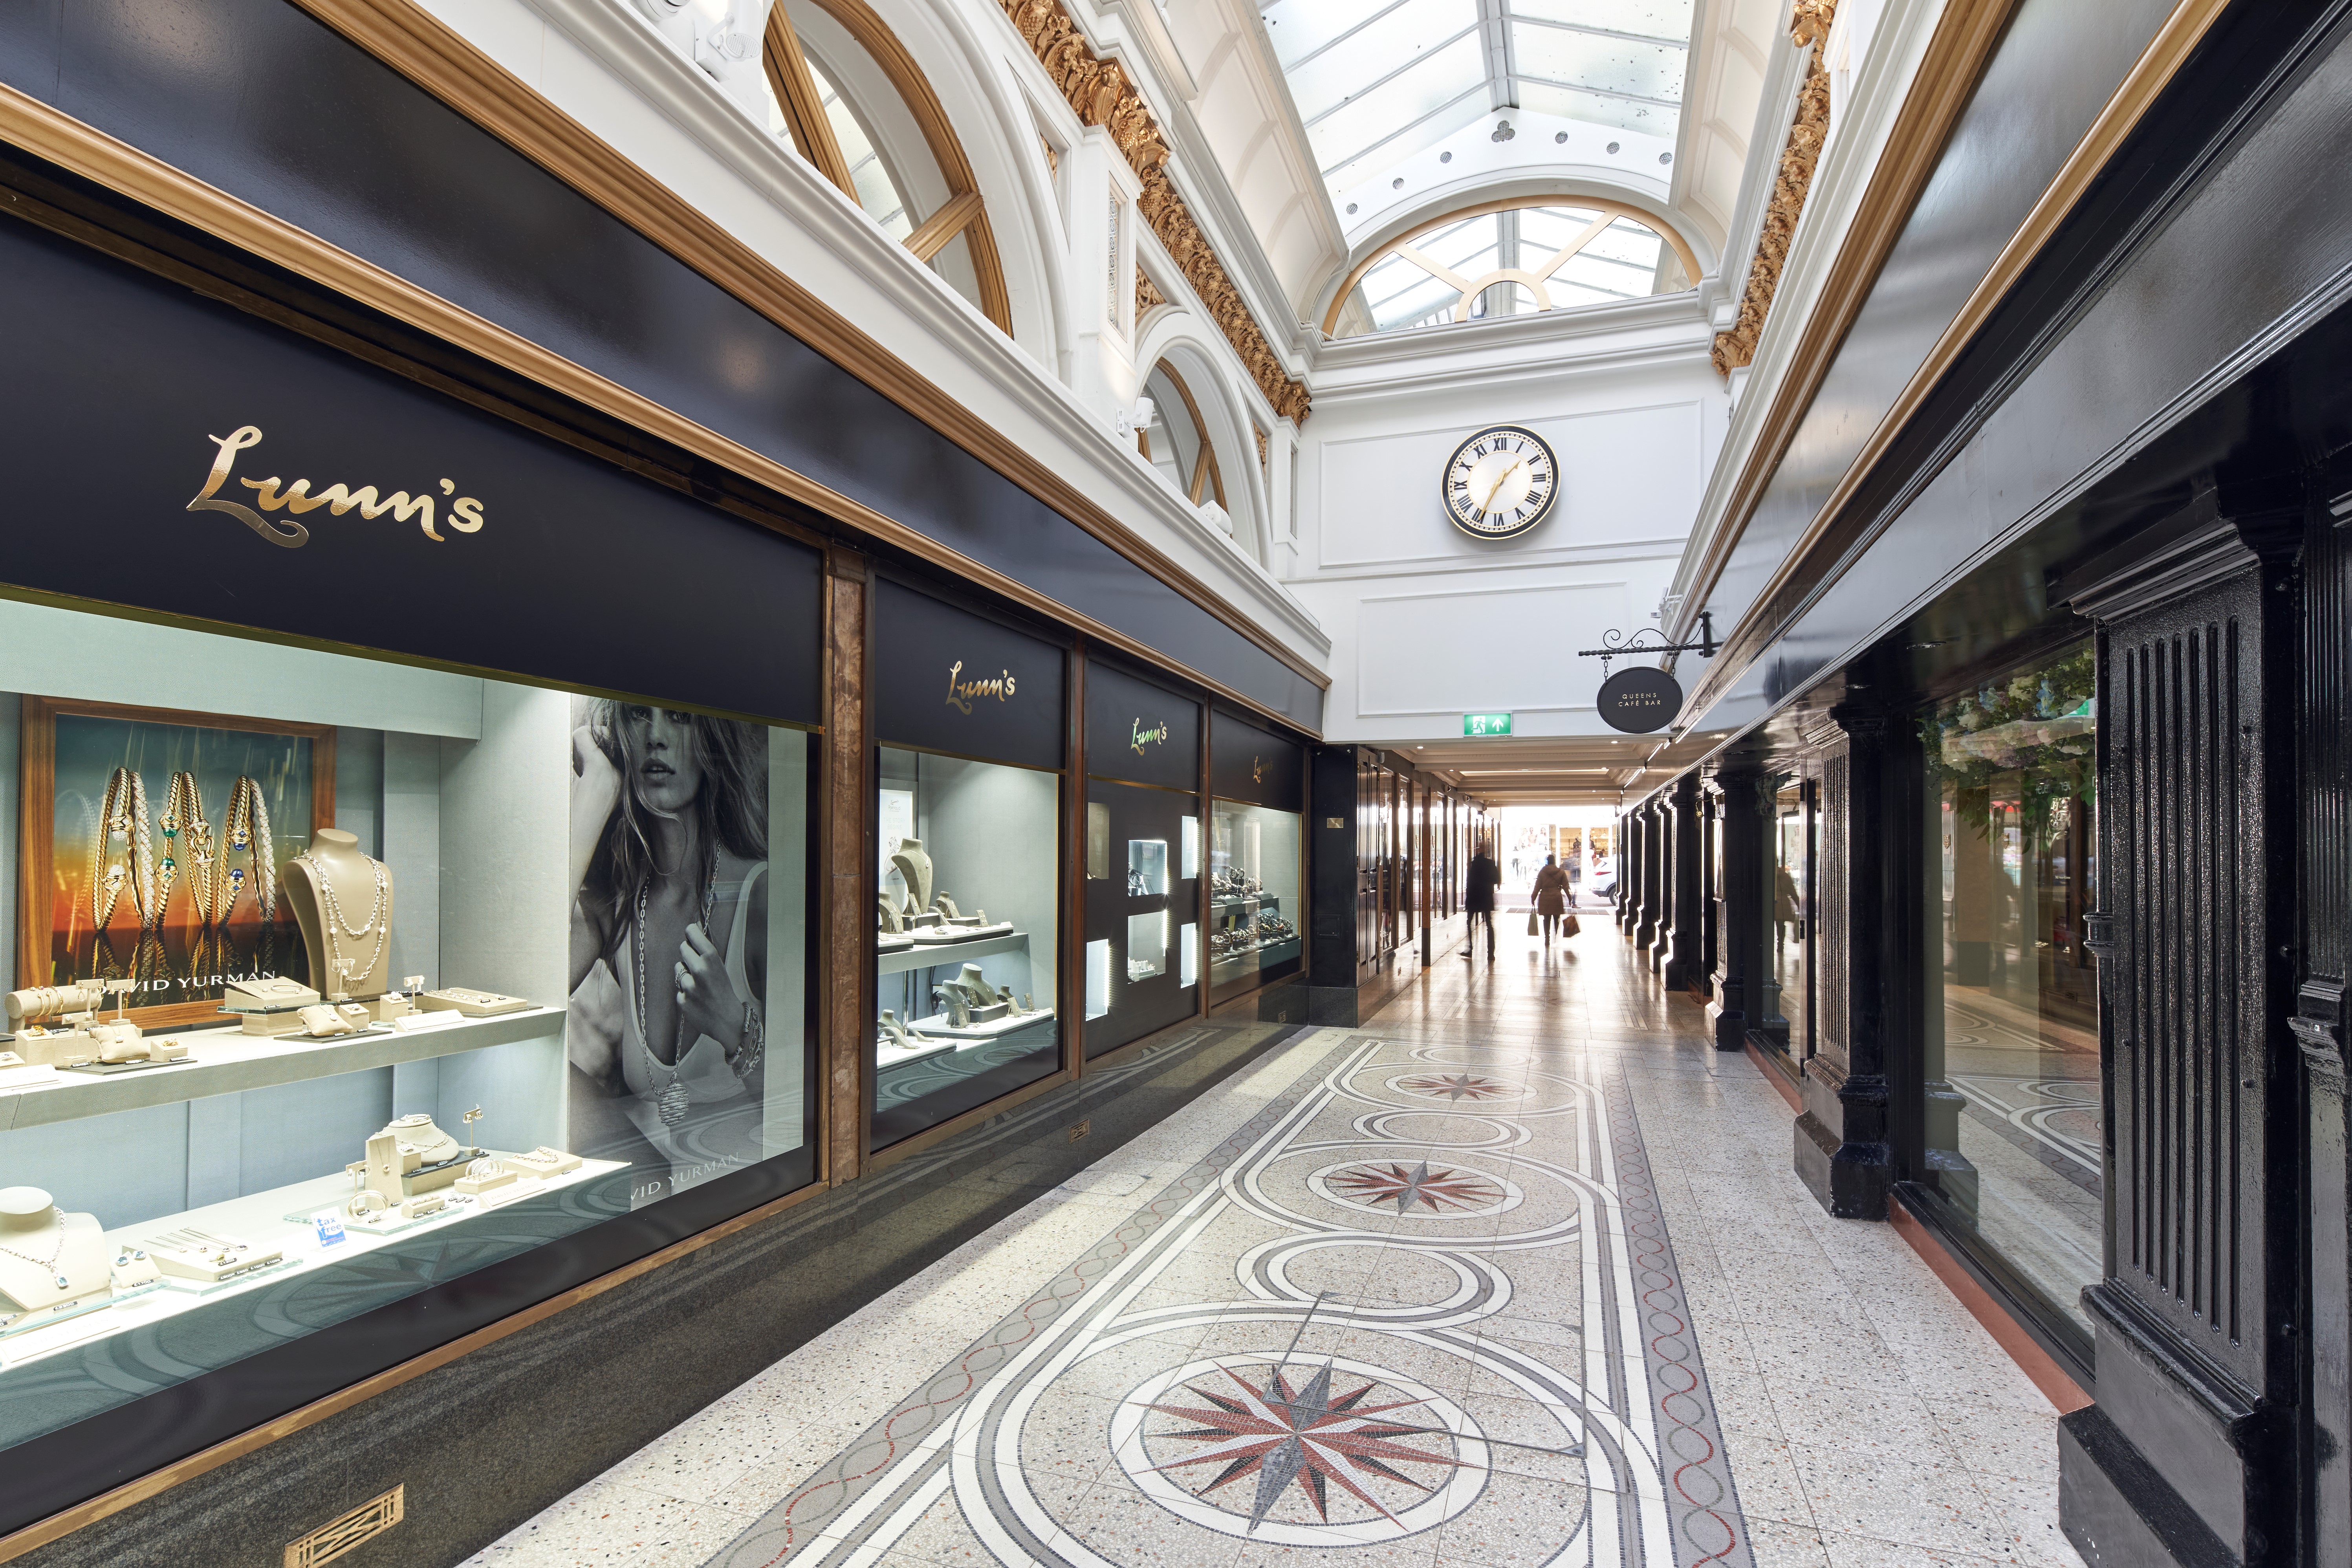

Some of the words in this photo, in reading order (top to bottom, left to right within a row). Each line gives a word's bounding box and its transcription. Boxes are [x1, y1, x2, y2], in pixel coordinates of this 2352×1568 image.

[1494, 438, 1506, 451] XII
[186, 426, 484, 548] Lunn's
[945, 661, 1015, 715] Lunn's
[1131, 718, 1167, 756] Lunn's
[1253, 756, 1273, 783] Lunn's
[177, 971, 275, 988] YURMAN
[668, 1152, 738, 1186] YURMAN
[317, 1218, 336, 1226] tax
[321, 1224, 342, 1238] free
